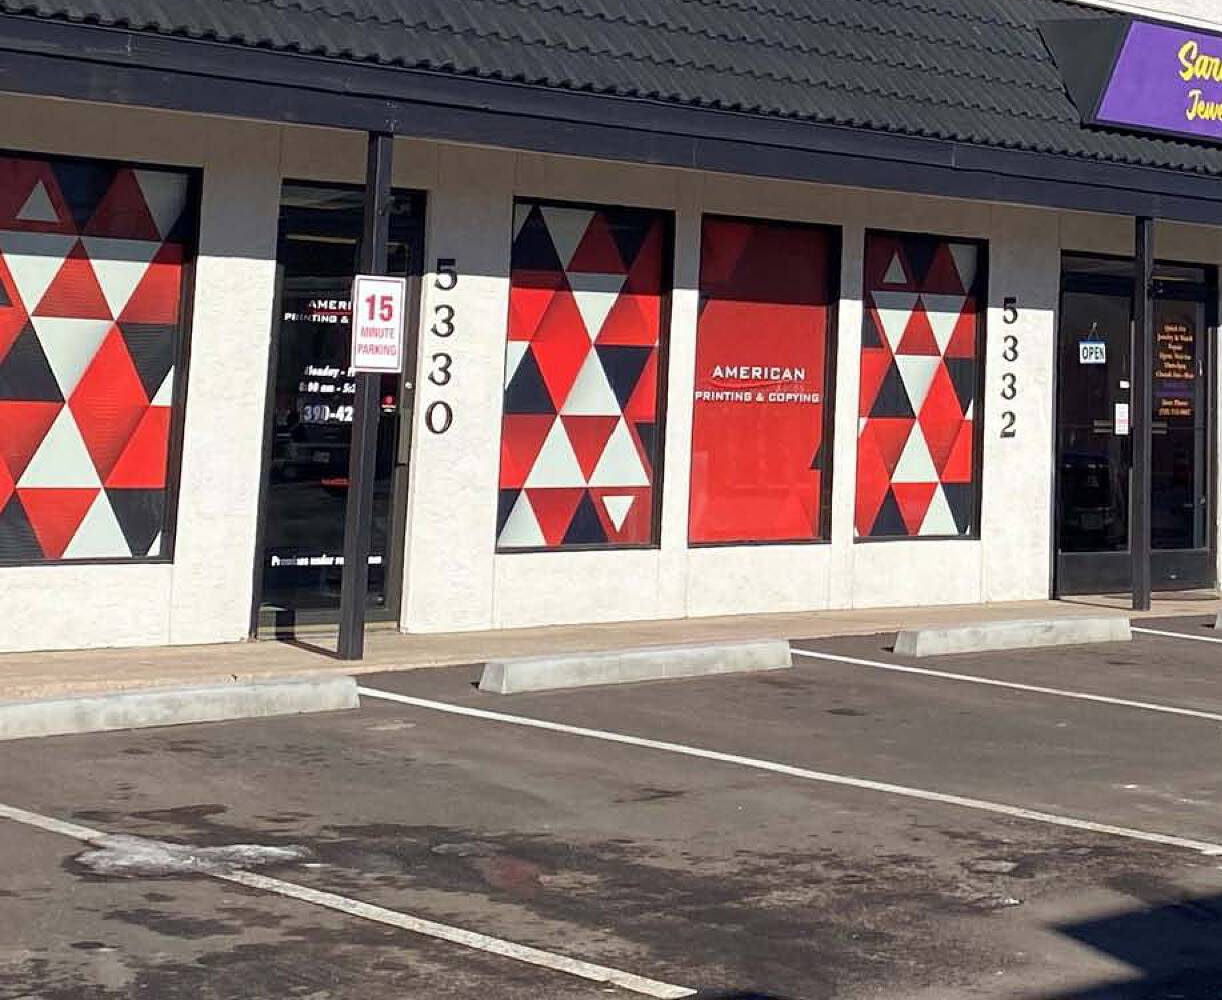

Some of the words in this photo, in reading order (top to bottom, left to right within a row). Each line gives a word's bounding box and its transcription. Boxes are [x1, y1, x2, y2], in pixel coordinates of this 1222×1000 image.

[364, 294, 394, 322] 15
[360, 326, 396, 340] MINUTE
[356, 343, 397, 357] PARKING
[424, 258, 458, 434] 5330
[1082, 346, 1105, 361] OPEN
[712, 365, 805, 381] AMERICAN
[1000, 296, 1019, 439] 5332
[695, 391, 752, 403] PRINTING
[756, 392, 764, 403] &
[768, 392, 820, 404] COPYING
